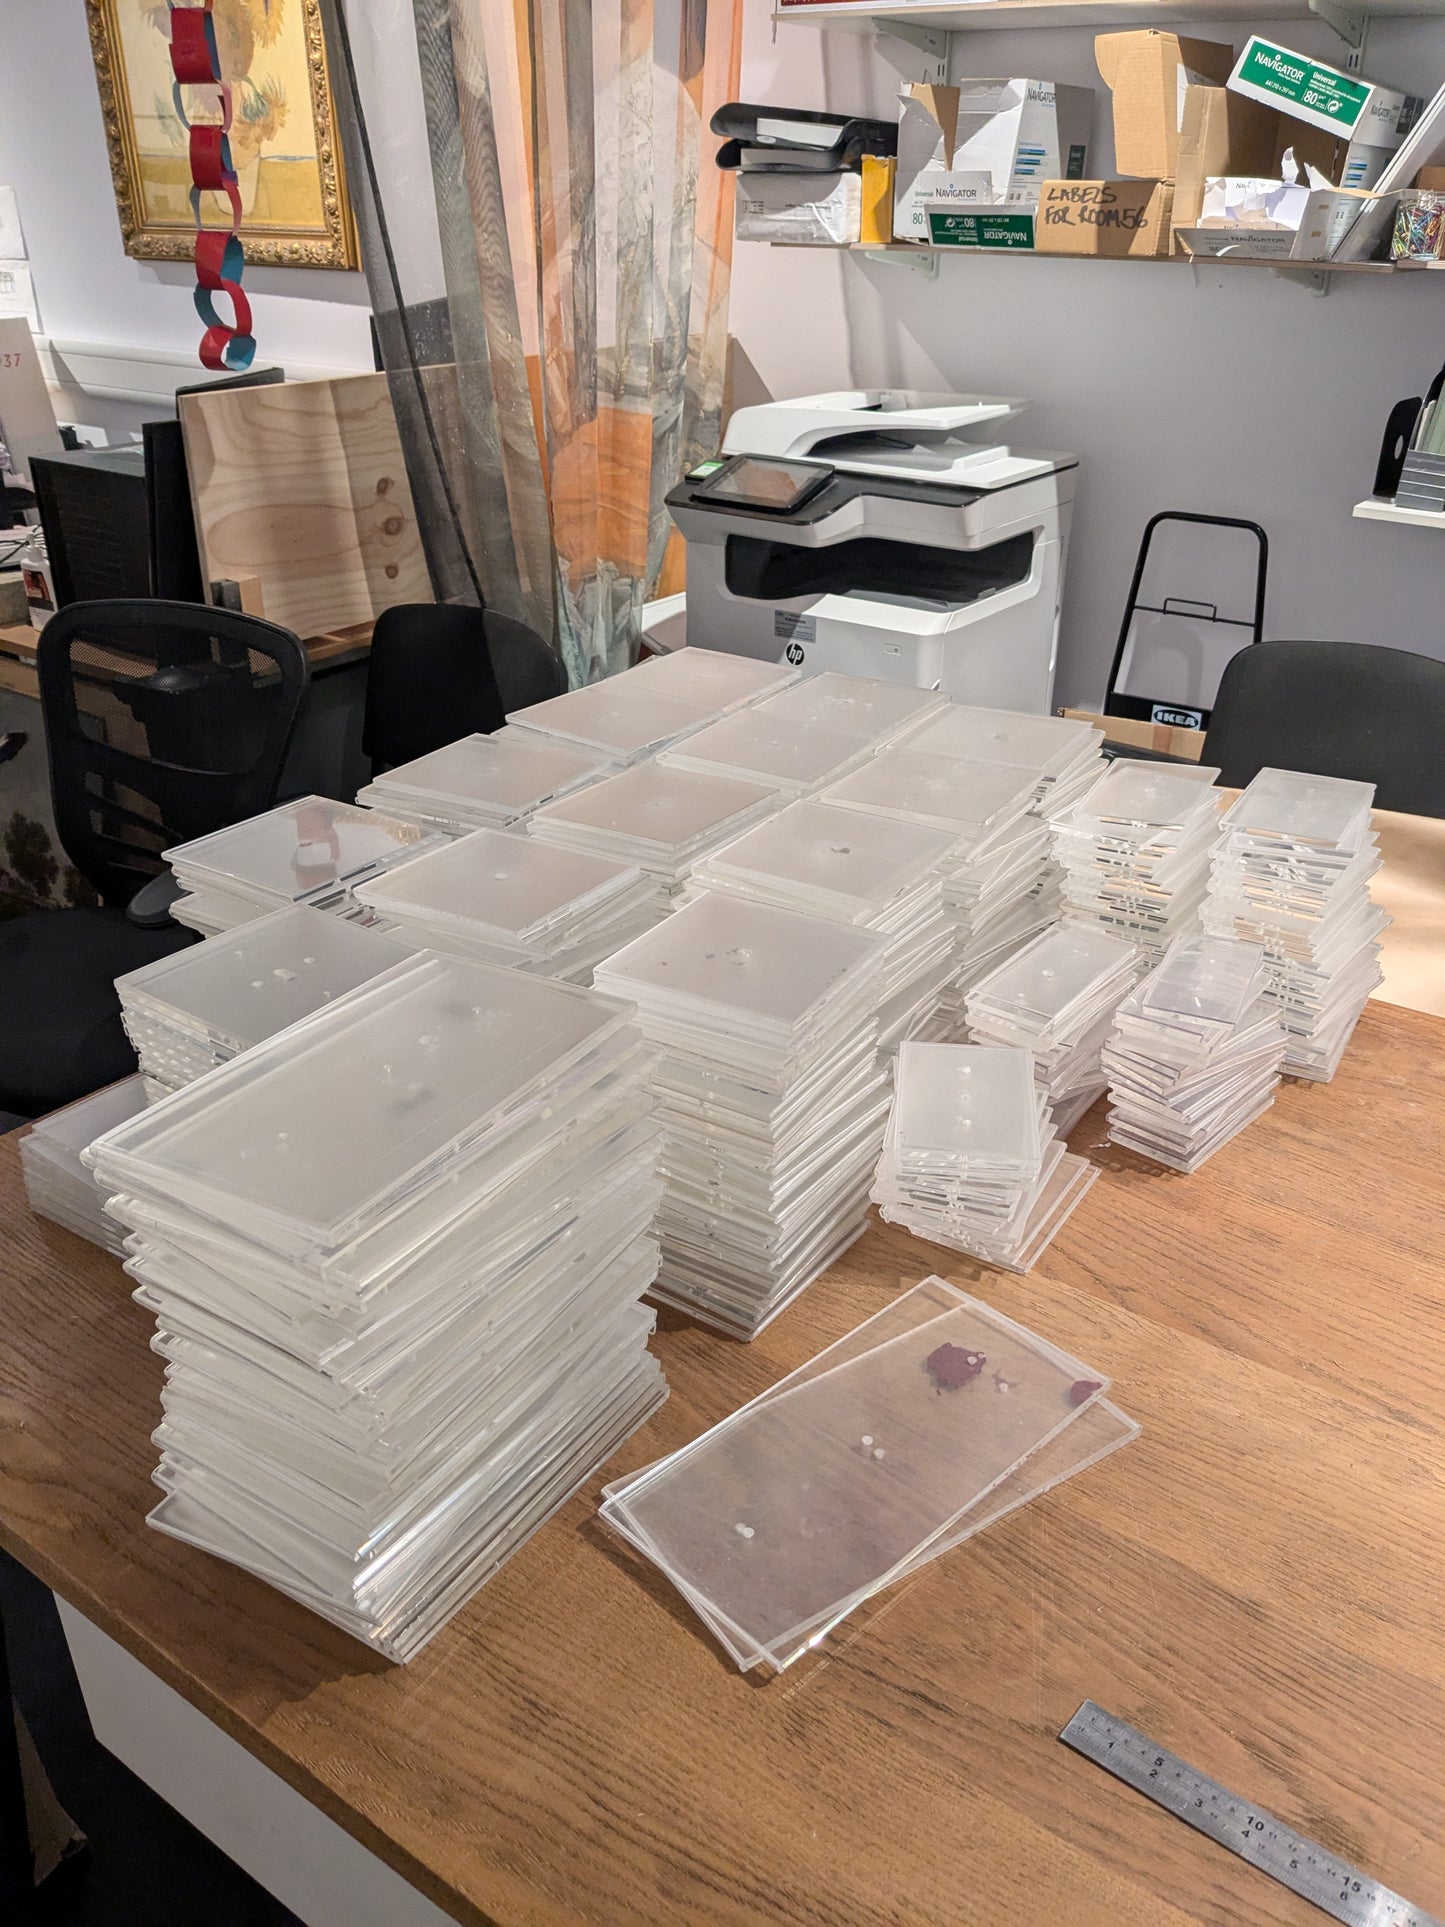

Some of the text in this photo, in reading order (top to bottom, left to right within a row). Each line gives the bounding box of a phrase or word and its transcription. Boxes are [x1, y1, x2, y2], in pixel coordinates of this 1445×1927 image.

[1254, 52, 1305, 81] NAVIGATOR
[1312, 71, 1337, 87] Universal
[1303, 90, 1318, 105] 80
[935, 187, 977, 198] NAVIGATOR
[1047, 186, 1118, 204] LABELS
[912, 212, 923, 225] 80
[1044, 205, 1076, 226] FOR
[983, 230, 1028, 242] NAVIGATOR
[0, 352, 21, 368] 37
[787, 643, 803, 665] hp
[1156, 711, 1196, 727] IKEA
[1108, 1741, 1114, 1749] 1
[1149, 1769, 1158, 1779] 2
[1194, 1798, 1203, 1808] 3
[1241, 1829, 1250, 1838] 4
[1289, 1859, 1298, 1869] 5
[1340, 1890, 1348, 1901] 6
[1154, 1757, 1164, 1767] 5
[1246, 1815, 1265, 1831] 10
[1342, 1876, 1362, 1892] 15
